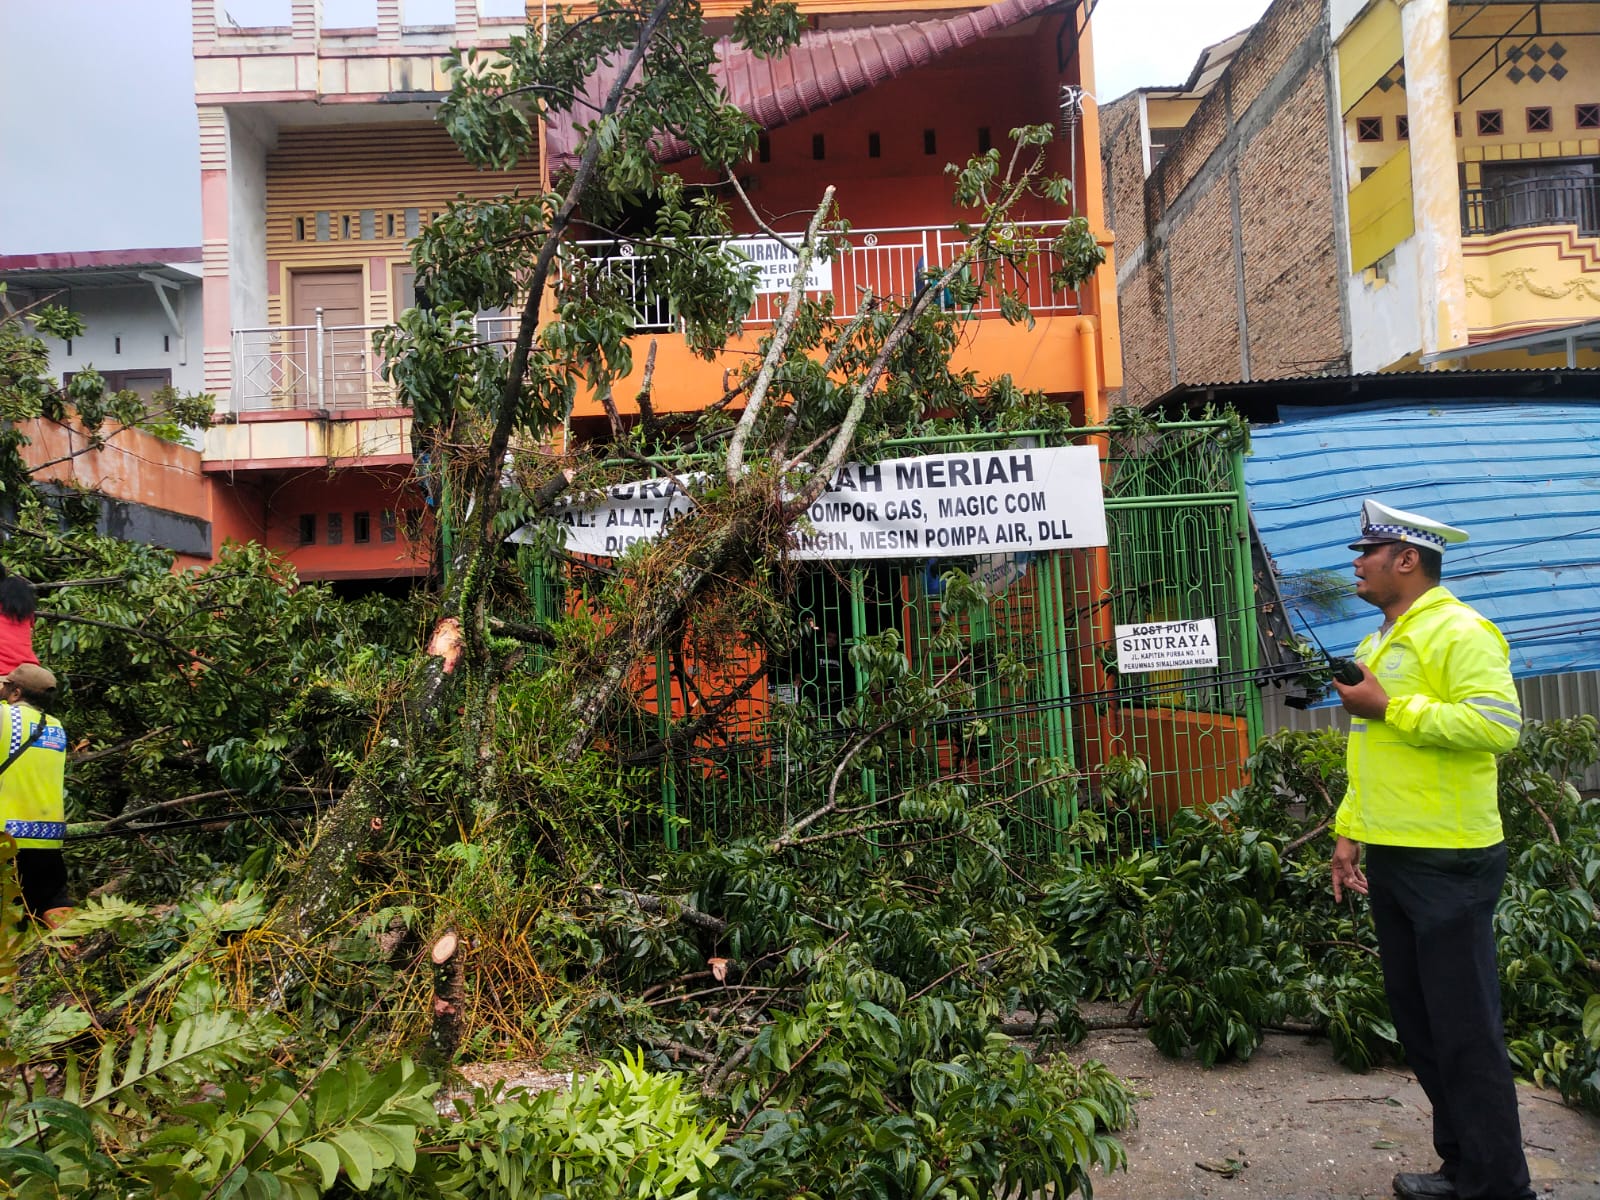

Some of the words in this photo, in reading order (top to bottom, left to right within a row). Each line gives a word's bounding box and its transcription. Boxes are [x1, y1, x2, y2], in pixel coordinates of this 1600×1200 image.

[896, 455, 1034, 490] MERIAH
[806, 502, 880, 522] OMPOR
[884, 499, 928, 522] GAS,
[938, 495, 999, 518] MAGIC
[1005, 492, 1046, 513] COM
[860, 528, 919, 550] MESIN
[925, 525, 990, 547] POMPA
[995, 522, 1032, 546] AIR,
[1039, 519, 1073, 541] DLL
[1133, 625, 1162, 636] KOST
[1167, 623, 1198, 633] PUTRI
[1123, 634, 1210, 652] SINURAYA
[1166, 650, 1185, 658] PURBA
[1124, 662, 1155, 670] PERUMNAS
[1156, 659, 1194, 668] SIMALINGKAR
[1194, 657, 1213, 665] MEDAN
